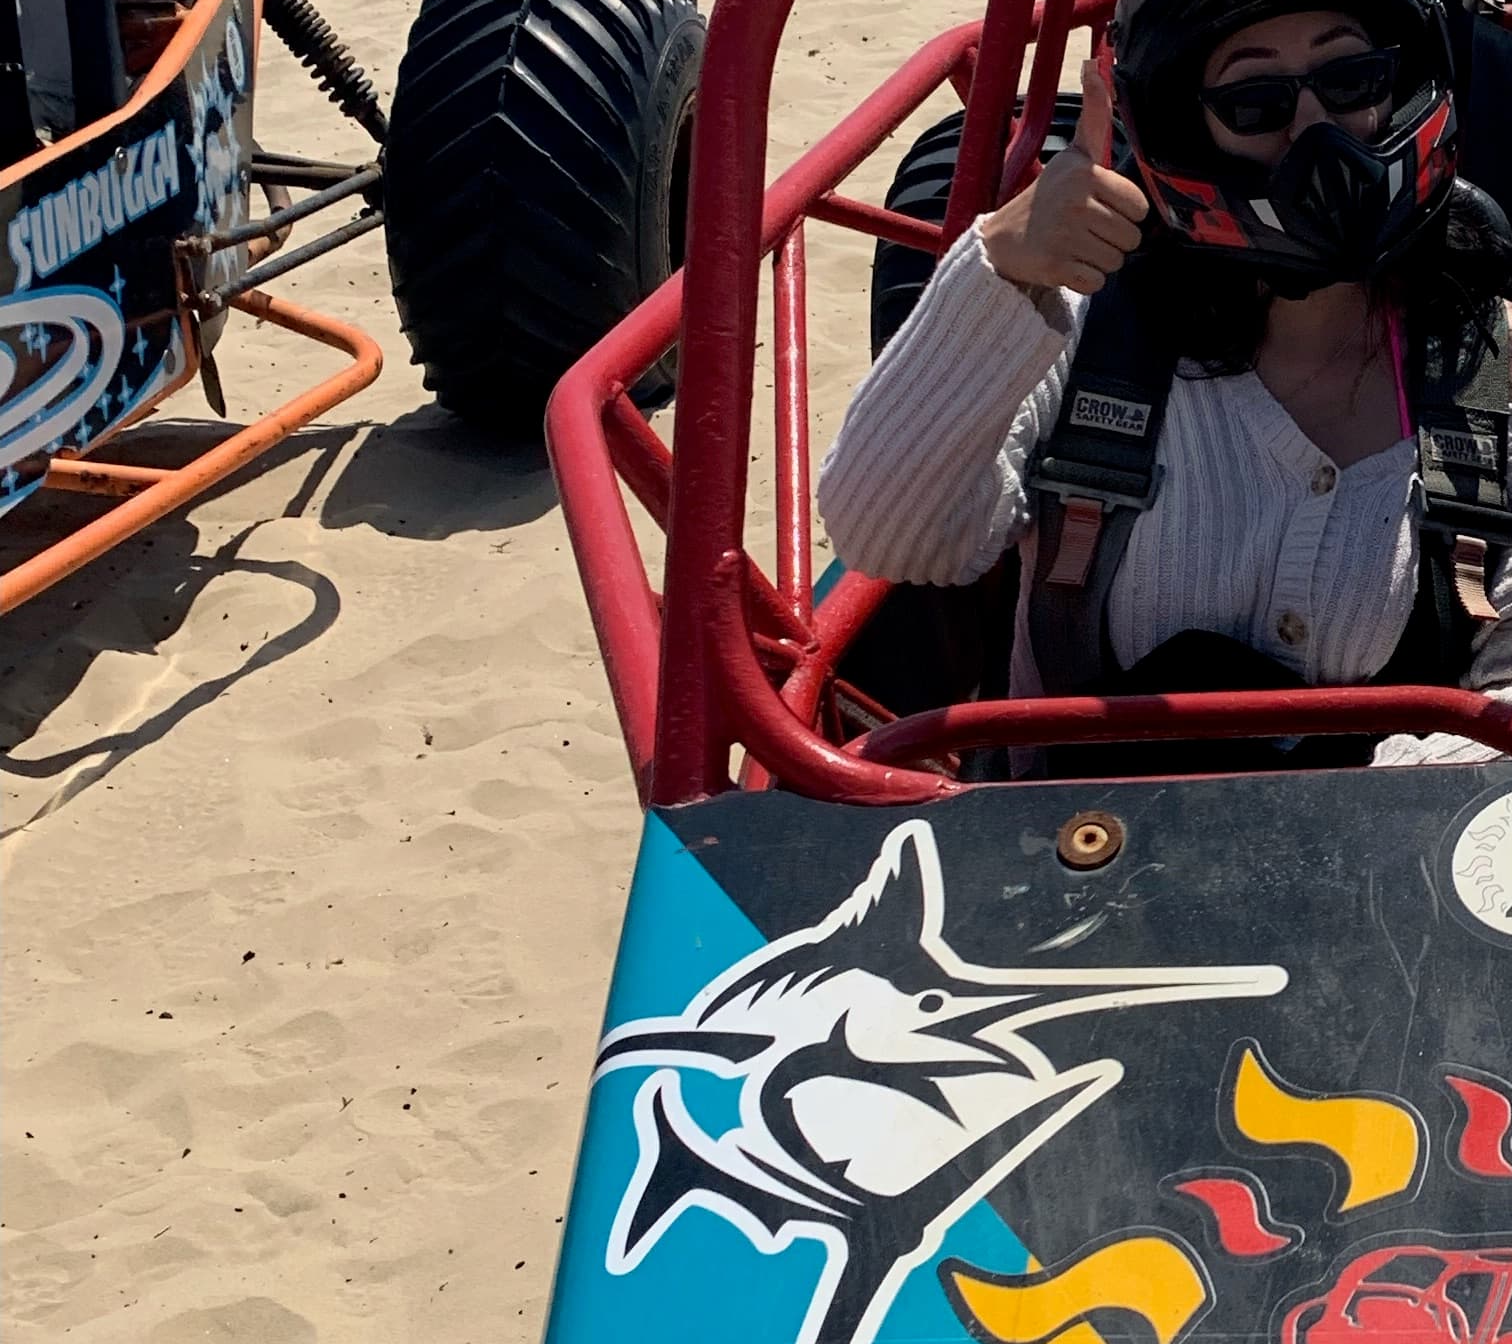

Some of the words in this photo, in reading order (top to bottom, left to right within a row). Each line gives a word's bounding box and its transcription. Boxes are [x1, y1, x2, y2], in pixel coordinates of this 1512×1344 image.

[8, 119, 181, 294] SUNBUGGY
[1074, 413, 1113, 425] SAFETY
[1077, 397, 1128, 419] CROW
